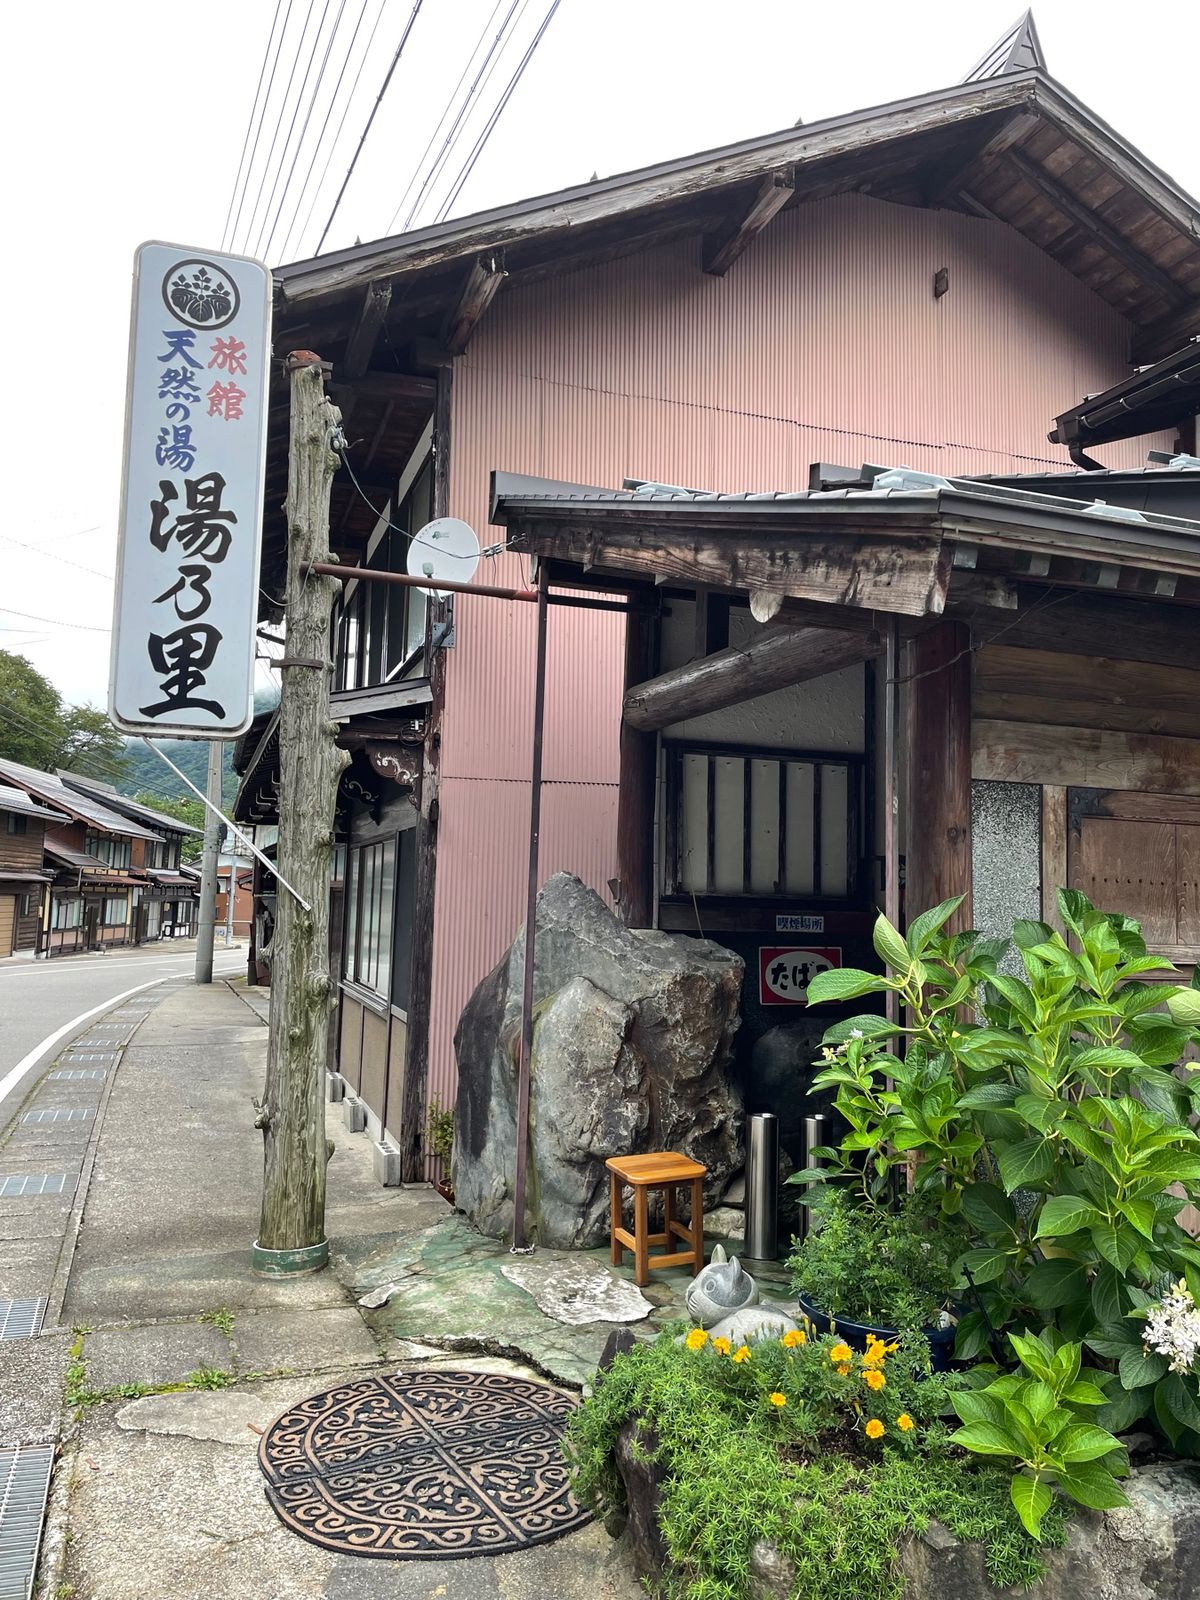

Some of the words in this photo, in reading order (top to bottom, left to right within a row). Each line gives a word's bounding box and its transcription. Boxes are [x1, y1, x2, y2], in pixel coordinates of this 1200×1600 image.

[155, 328, 204, 472] 天然の湯
[206, 335, 248, 421] 旅館
[138, 471, 239, 719] 湯乃里
[777, 916, 823, 931] 喫煙場所
